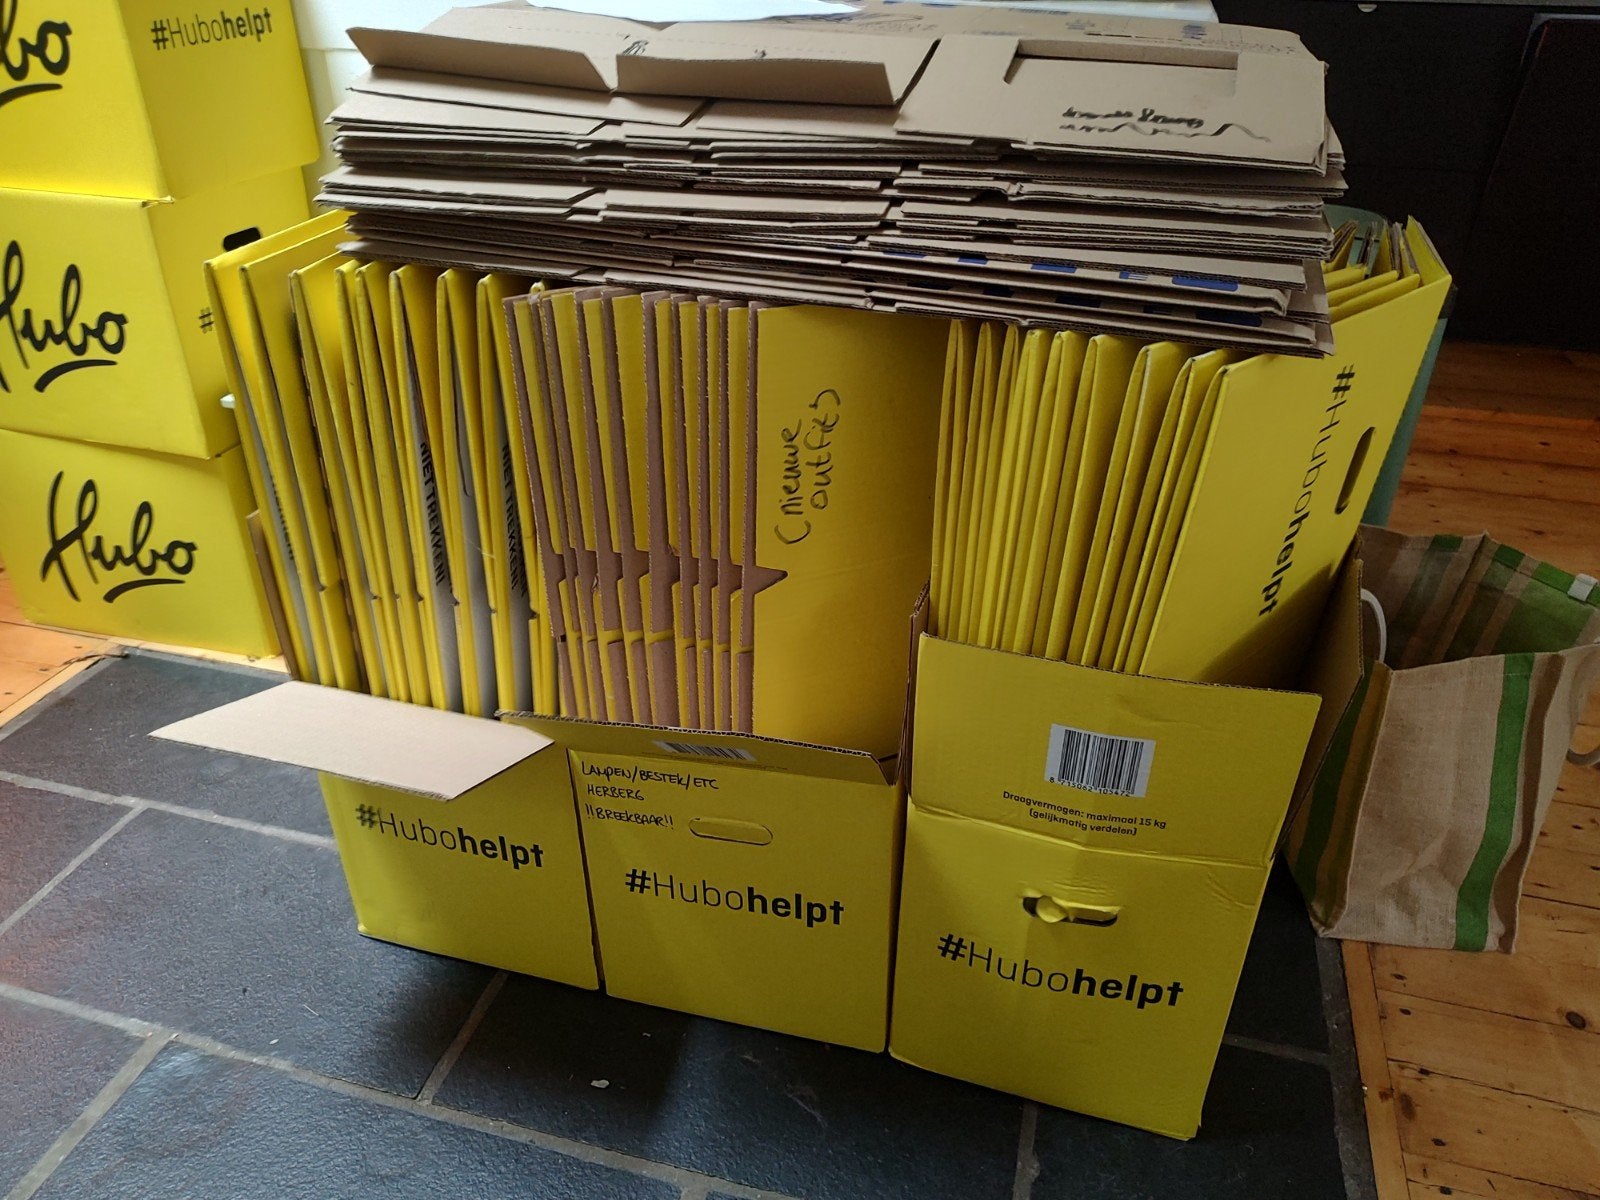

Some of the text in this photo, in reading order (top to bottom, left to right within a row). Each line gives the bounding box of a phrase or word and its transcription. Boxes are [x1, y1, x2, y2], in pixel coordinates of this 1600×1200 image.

[151, 7, 273, 50] #Hubohelpt
[1258, 363, 1356, 618] #Hubohelpt
[40, 470, 199, 602] Hubo
[584, 802, 675, 831] !!BREEKBAAR!!
[587, 783, 645, 802] HERBERG
[1002, 790, 1167, 830] Draagvermogen: maximaal 15 kg
[355, 802, 545, 871] #Hubohelpt
[1029, 807, 1138, 836] (gelijkmatig verdelen)
[624, 868, 845, 928] #Hubohelpt
[936, 932, 1185, 1010] #Hubohelpt
